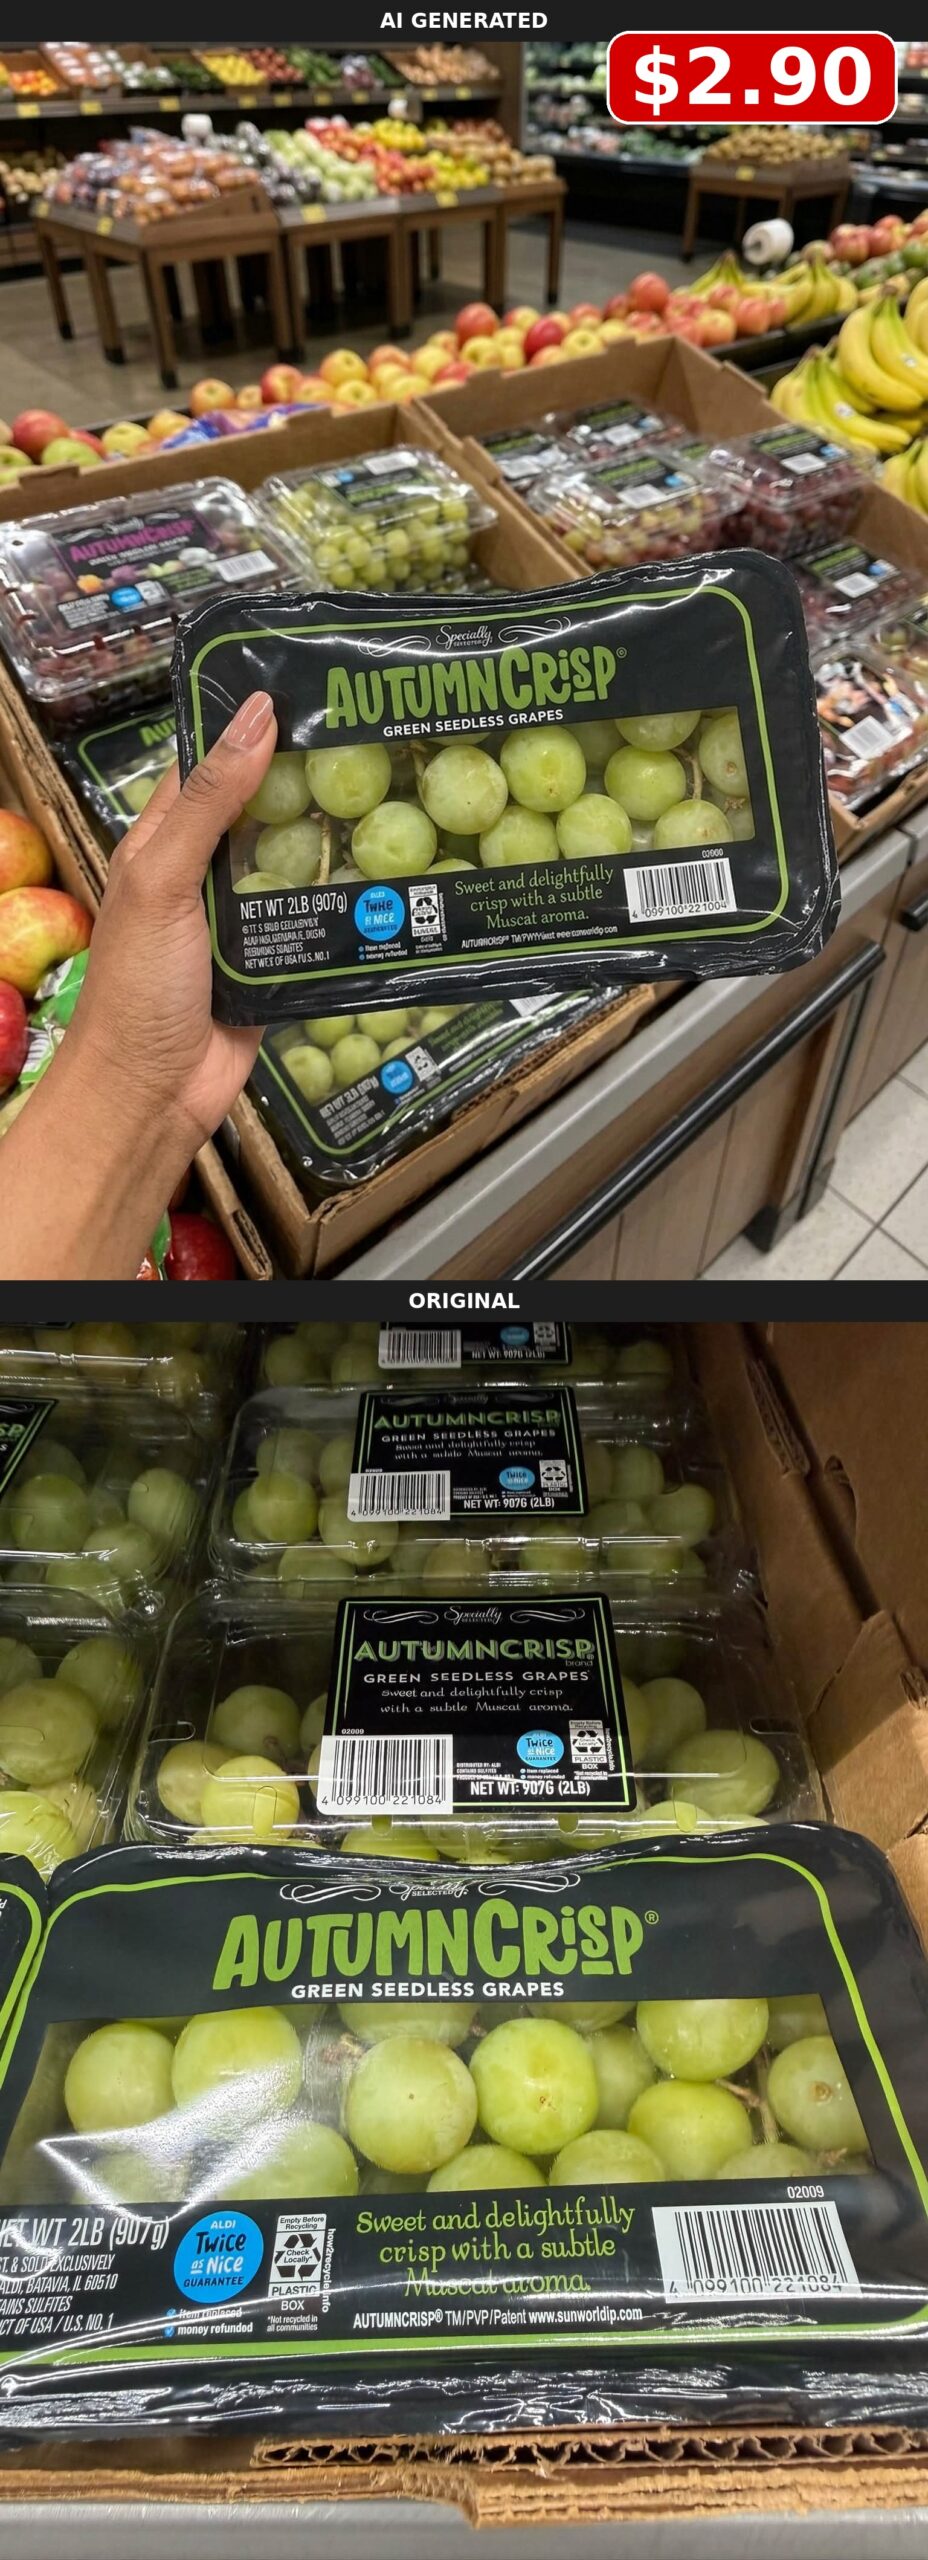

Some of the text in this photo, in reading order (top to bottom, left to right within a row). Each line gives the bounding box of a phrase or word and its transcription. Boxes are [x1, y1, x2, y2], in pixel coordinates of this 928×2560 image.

[435, 624, 493, 650] Specially
[383, 709, 564, 738] GREEN SEEDLESS GRAPES
[455, 880, 494, 896] Sweet
[498, 873, 526, 891] and
[529, 861, 614, 890] delightfully
[240, 900, 263, 920] NET
[265, 898, 284, 917] WT
[287, 895, 310, 915] 2LB
[312, 892, 347, 914] (907g)
[470, 885, 603, 915] crisp with a subtle
[486, 908, 590, 930] Muscat aroma.
[632, 911, 638, 919] 4
[381, 1429, 556, 1443] GREEN SEEDLESS GRAPES
[463, 1496, 555, 1509] NET WT: 907G (2LB)
[565, 1659, 594, 1667] brand
[364, 1670, 589, 1683] GREEN SEEDLESS GRAPES
[420, 1686, 445, 1698] and
[450, 1685, 526, 1699] delightfully
[529, 1687, 563, 1699] crisp
[380, 1701, 574, 1713] with a subtle Muscat aroma.
[525, 1737, 553, 1747] Twice
[536, 1747, 556, 1756] Nice
[471, 1780, 590, 1796] NET WT: 907G (2LB)
[322, 1794, 442, 1806] 4 099100 221084
[412, 1889, 454, 1897] SELECTED
[291, 1981, 565, 1999] GREEN SEEDLESS GRAPES
[787, 2185, 825, 2199] 02009
[280, 2217, 300, 2225] Empty
[356, 2196, 636, 2236] Sweet and delightfully
[210, 2220, 236, 2229] ALDI
[285, 2222, 318, 2230] Recycling
[32, 2218, 66, 2247] WT
[68, 2217, 105, 2247] 2LB
[109, 2216, 170, 2251] (907g)
[196, 2232, 246, 2255] Twice
[379, 2228, 616, 2273] crisp with a subtle
[11, 2256, 18, 2272] &
[50, 2254, 116, 2272] EXCLUSIVELY
[190, 2257, 243, 2275] as Nice
[26, 2276, 71, 2294] BATAVIA,
[72, 2275, 82, 2291] IL
[84, 2273, 118, 2291] 60510
[183, 2276, 244, 2288] GUARANTEE
[405, 2267, 591, 2297] Muscat aroma.
[271, 2286, 317, 2297] PLASTIC
[25, 2296, 73, 2314] SULFITES
[281, 2300, 305, 2311] BOX
[15, 2317, 31, 2334] OF
[30, 2316, 53, 2334] USA
[53, 2316, 64, 2332] /
[63, 2314, 83, 2332] U.S.
[85, 2313, 104, 2331] NO.
[108, 2312, 114, 2330] 1
[283, 2315, 310, 2324] recycled
[311, 2314, 318, 2322] in
[353, 2305, 643, 2329] AUTUMNCRISP® TM/PVP/Patent www.sunworldip.com
[178, 2321, 253, 2337] money refunded
[267, 2323, 318, 2332] all communities
